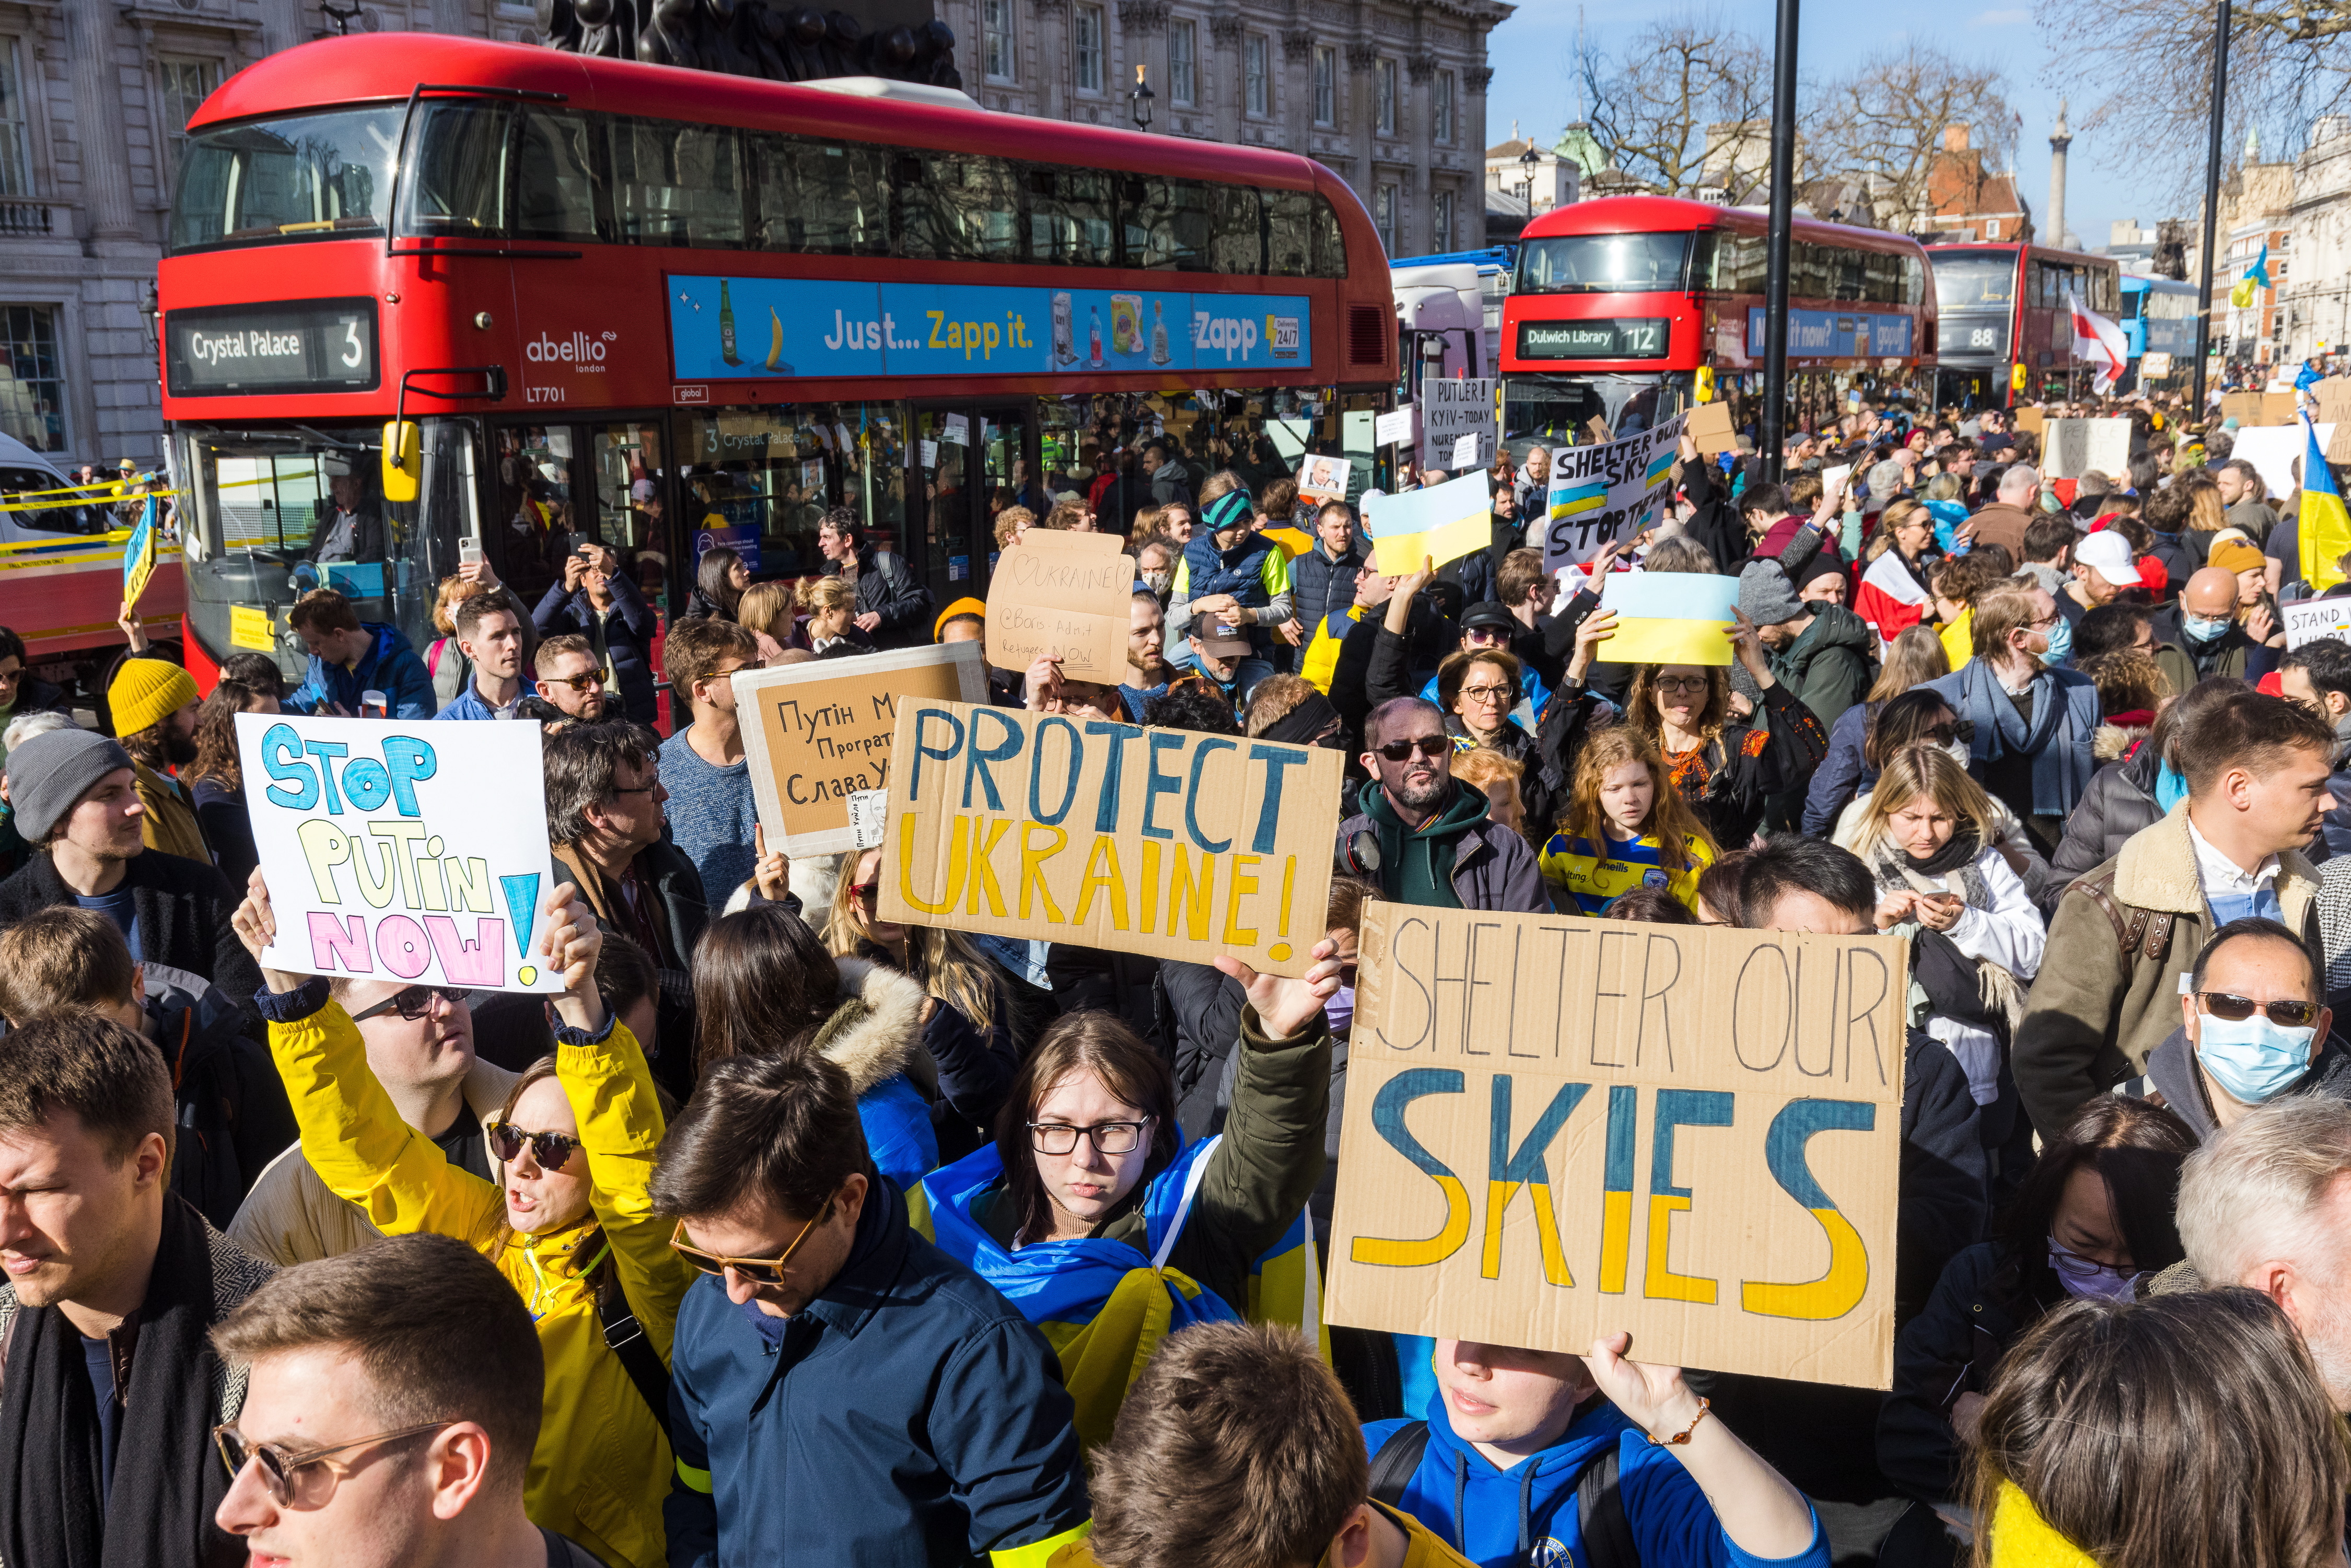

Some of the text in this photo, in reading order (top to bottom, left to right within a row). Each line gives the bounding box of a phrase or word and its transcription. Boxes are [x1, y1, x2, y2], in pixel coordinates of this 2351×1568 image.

[824, 309, 1033, 361] Just... Zapp it.
[1195, 311, 1257, 361] Zapp
[1277, 320, 1297, 329] Delivering
[1278, 330, 1297, 345] 24/7
[1971, 328, 1993, 347] 88
[192, 316, 363, 367] Crystal Palace 3
[526, 331, 606, 362] abellio
[1528, 327, 1654, 350] Dulwich Library 12
[576, 364, 606, 373] london
[527, 387, 565, 402] LT701
[681, 388, 701, 401] global
[706, 429, 800, 453] 3 Crystal Palace
[2064, 424, 2122, 439] PEACE
[1556, 420, 1680, 479] SHELTER OUR
[2069, 440, 2109, 457] NOT
[1601, 452, 1651, 489] SKY
[1550, 509, 1626, 556] STOP
[1035, 564, 1113, 590] UKRAINE
[1056, 620, 1092, 636] Admit
[2291, 609, 2340, 631] STAND
[1003, 639, 1092, 663] Refugees NOW
[777, 700, 855, 744] Путін
[817, 731, 894, 760] Програт
[262, 723, 437, 817] STOP
[910, 708, 1308, 855] PROTECT
[787, 773, 868, 805] Слава
[900, 811, 1297, 962] UKRAINE!
[1376, 917, 1889, 1086] SHELTER OUR
[1351, 1067, 1876, 1322] SKIES
[1533, 1538, 1568, 1560] UNIVERSITY
